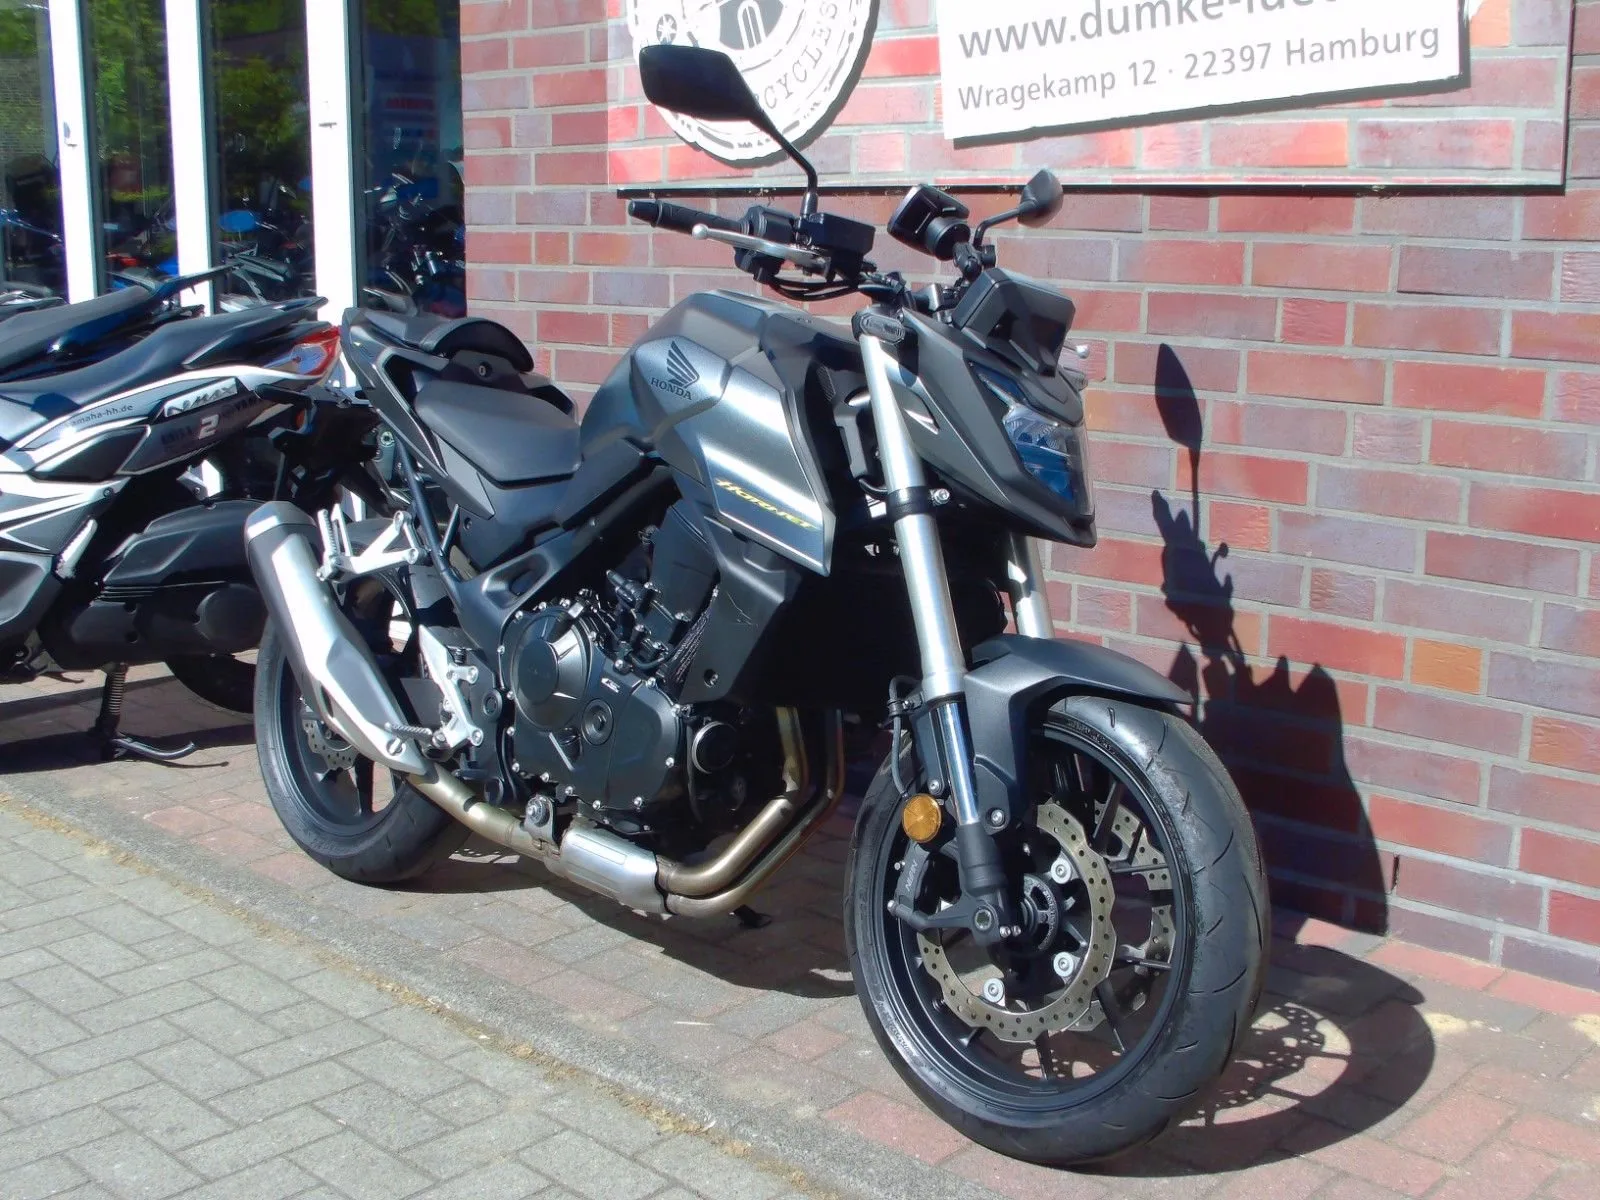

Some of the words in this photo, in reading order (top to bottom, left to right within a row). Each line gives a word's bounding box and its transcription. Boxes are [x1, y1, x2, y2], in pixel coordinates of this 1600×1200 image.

[958, 0, 1337, 59] www.dumke-
[754, 3, 838, 110] CYCLES
[958, 71, 1116, 111] Wragekamp
[1127, 59, 1157, 87] 12
[1184, 42, 1272, 80] 22397
[1286, 27, 1439, 66] Hamburg
[650, 377, 692, 401] HONDA
[67, 404, 133, 427] amaha-hh.de
[198, 413, 220, 441] 2
